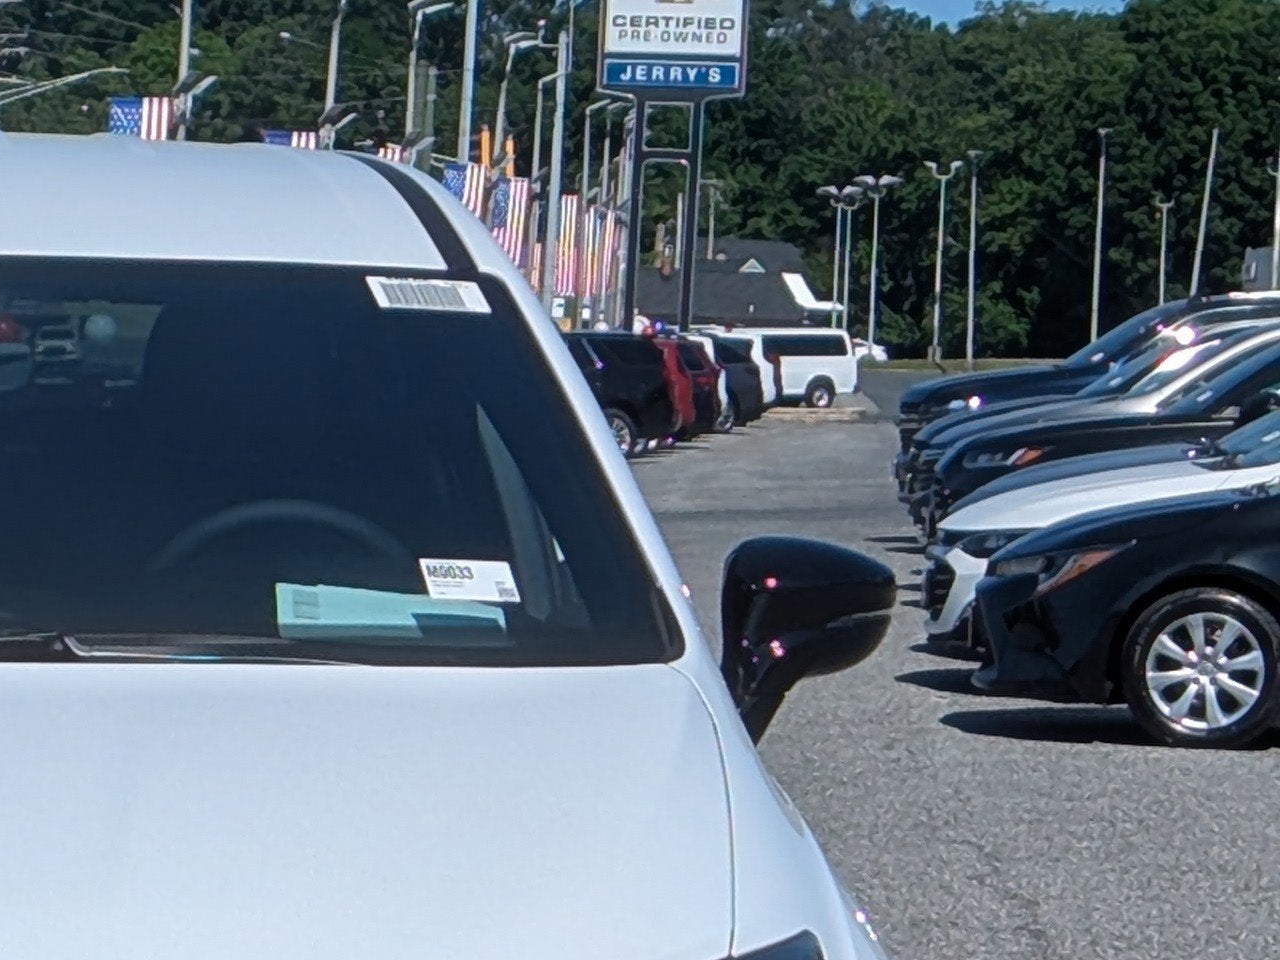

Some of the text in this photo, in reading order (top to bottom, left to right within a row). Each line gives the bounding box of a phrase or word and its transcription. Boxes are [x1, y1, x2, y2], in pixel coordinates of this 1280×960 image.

[612, 14, 736, 30] CERTIFIED
[618, 29, 728, 44] PRE-OWNED
[620, 64, 721, 83] JERRY'S
